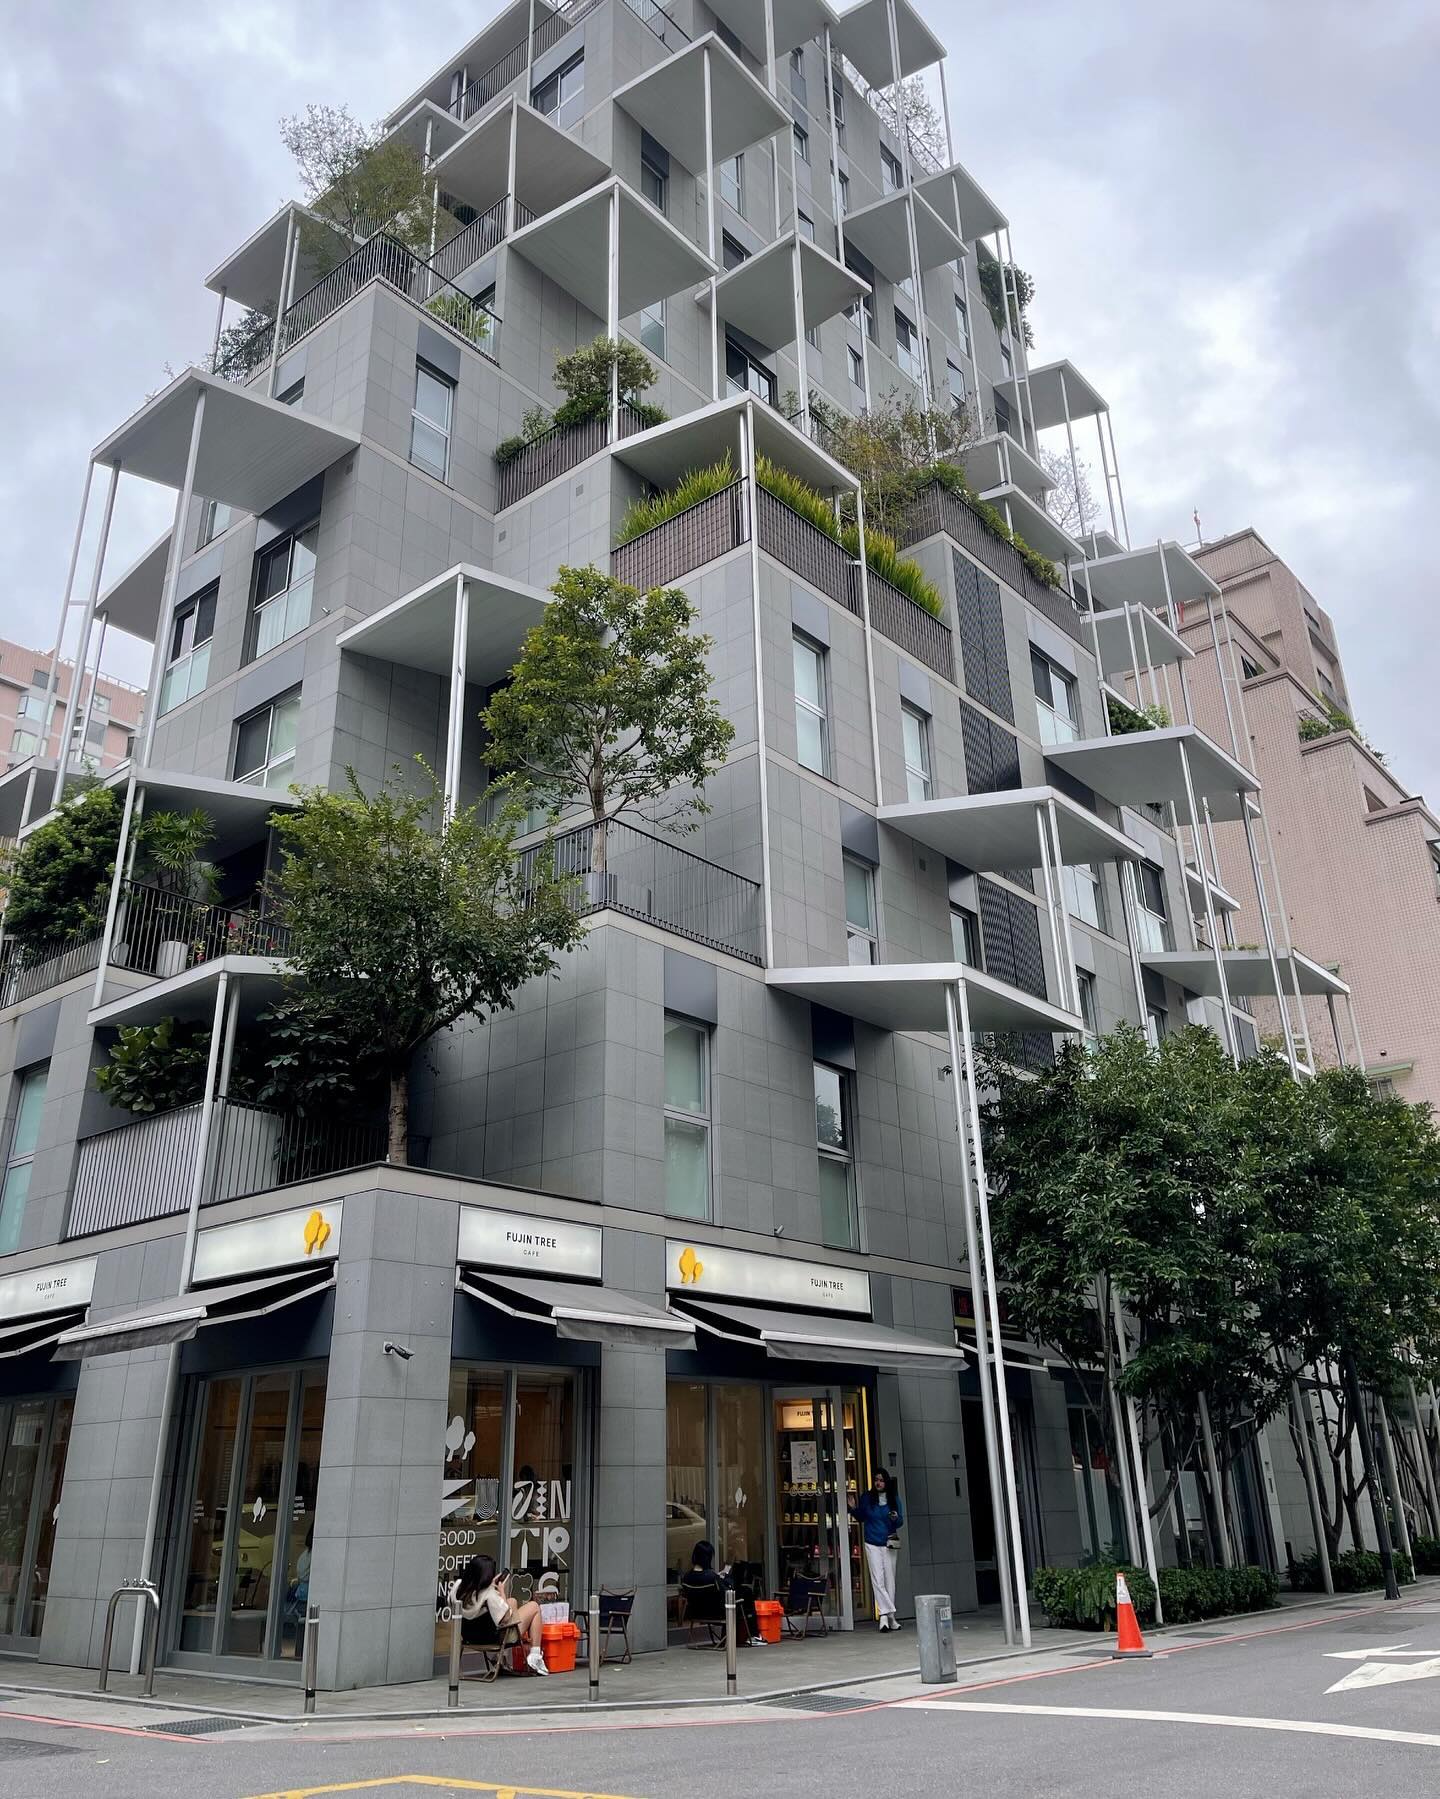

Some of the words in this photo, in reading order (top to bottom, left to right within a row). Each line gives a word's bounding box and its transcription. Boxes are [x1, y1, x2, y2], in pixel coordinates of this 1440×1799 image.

[506, 1232, 533, 1244] FUJIN
[535, 1236, 557, 1248] TREE
[36, 1281, 53, 1292] FUJIN
[53, 1278, 67, 1288] TREE
[810, 1278, 828, 1288] FUJIN
[829, 1281, 844, 1290] TREE
[440, 1530, 476, 1546] GOOD
[437, 1554, 478, 1571] COFF
